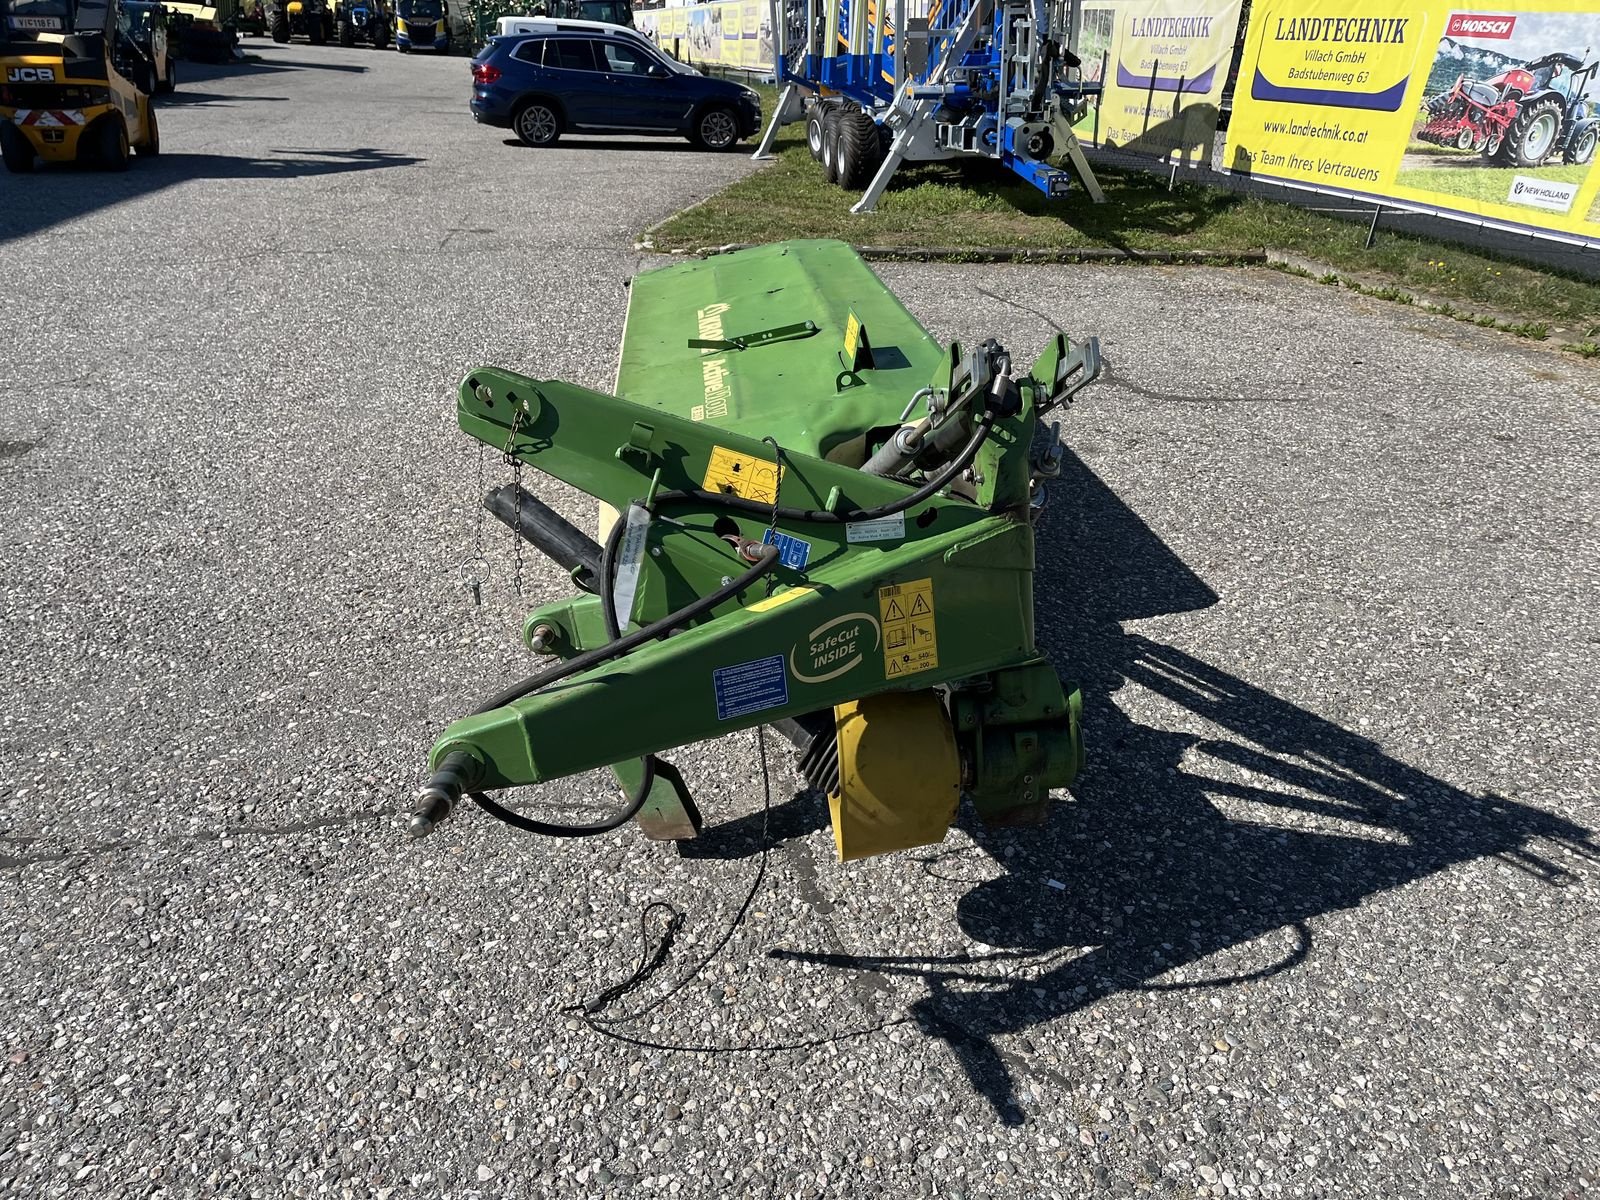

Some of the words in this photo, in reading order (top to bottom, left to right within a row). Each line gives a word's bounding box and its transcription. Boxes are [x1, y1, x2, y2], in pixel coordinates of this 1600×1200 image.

[1131, 16, 1213, 38] LANDTECHNIK
[1275, 17, 1409, 43] LANDTECHNIK
[1460, 19, 1511, 33] HORSCH
[1150, 44, 1169, 55] Villach
[1170, 44, 1188, 56] GmbH
[1305, 50, 1334, 62] Villach
[1335, 51, 1366, 64] GmbH
[8, 67, 54, 81] JCB
[1179, 61, 1189, 72] 63
[1288, 67, 1354, 85] Badstubenweg
[1356, 71, 1370, 84] 63
[1107, 126, 1119, 138] Das
[1121, 128, 1138, 141] Team
[1264, 118, 1369, 144] www.landtechnik.co.at
[1239, 147, 1257, 163] Das
[1260, 150, 1286, 167] Team
[1287, 153, 1314, 171] Ihres
[1316, 157, 1380, 182] Vertrauens
[1524, 186, 1540, 196] NEW
[1540, 188, 1570, 200] HOLLAND
[703, 359, 732, 419] ActiveMow
[809, 625, 860, 656] SafeCut
[814, 641, 856, 669] INSIDE
